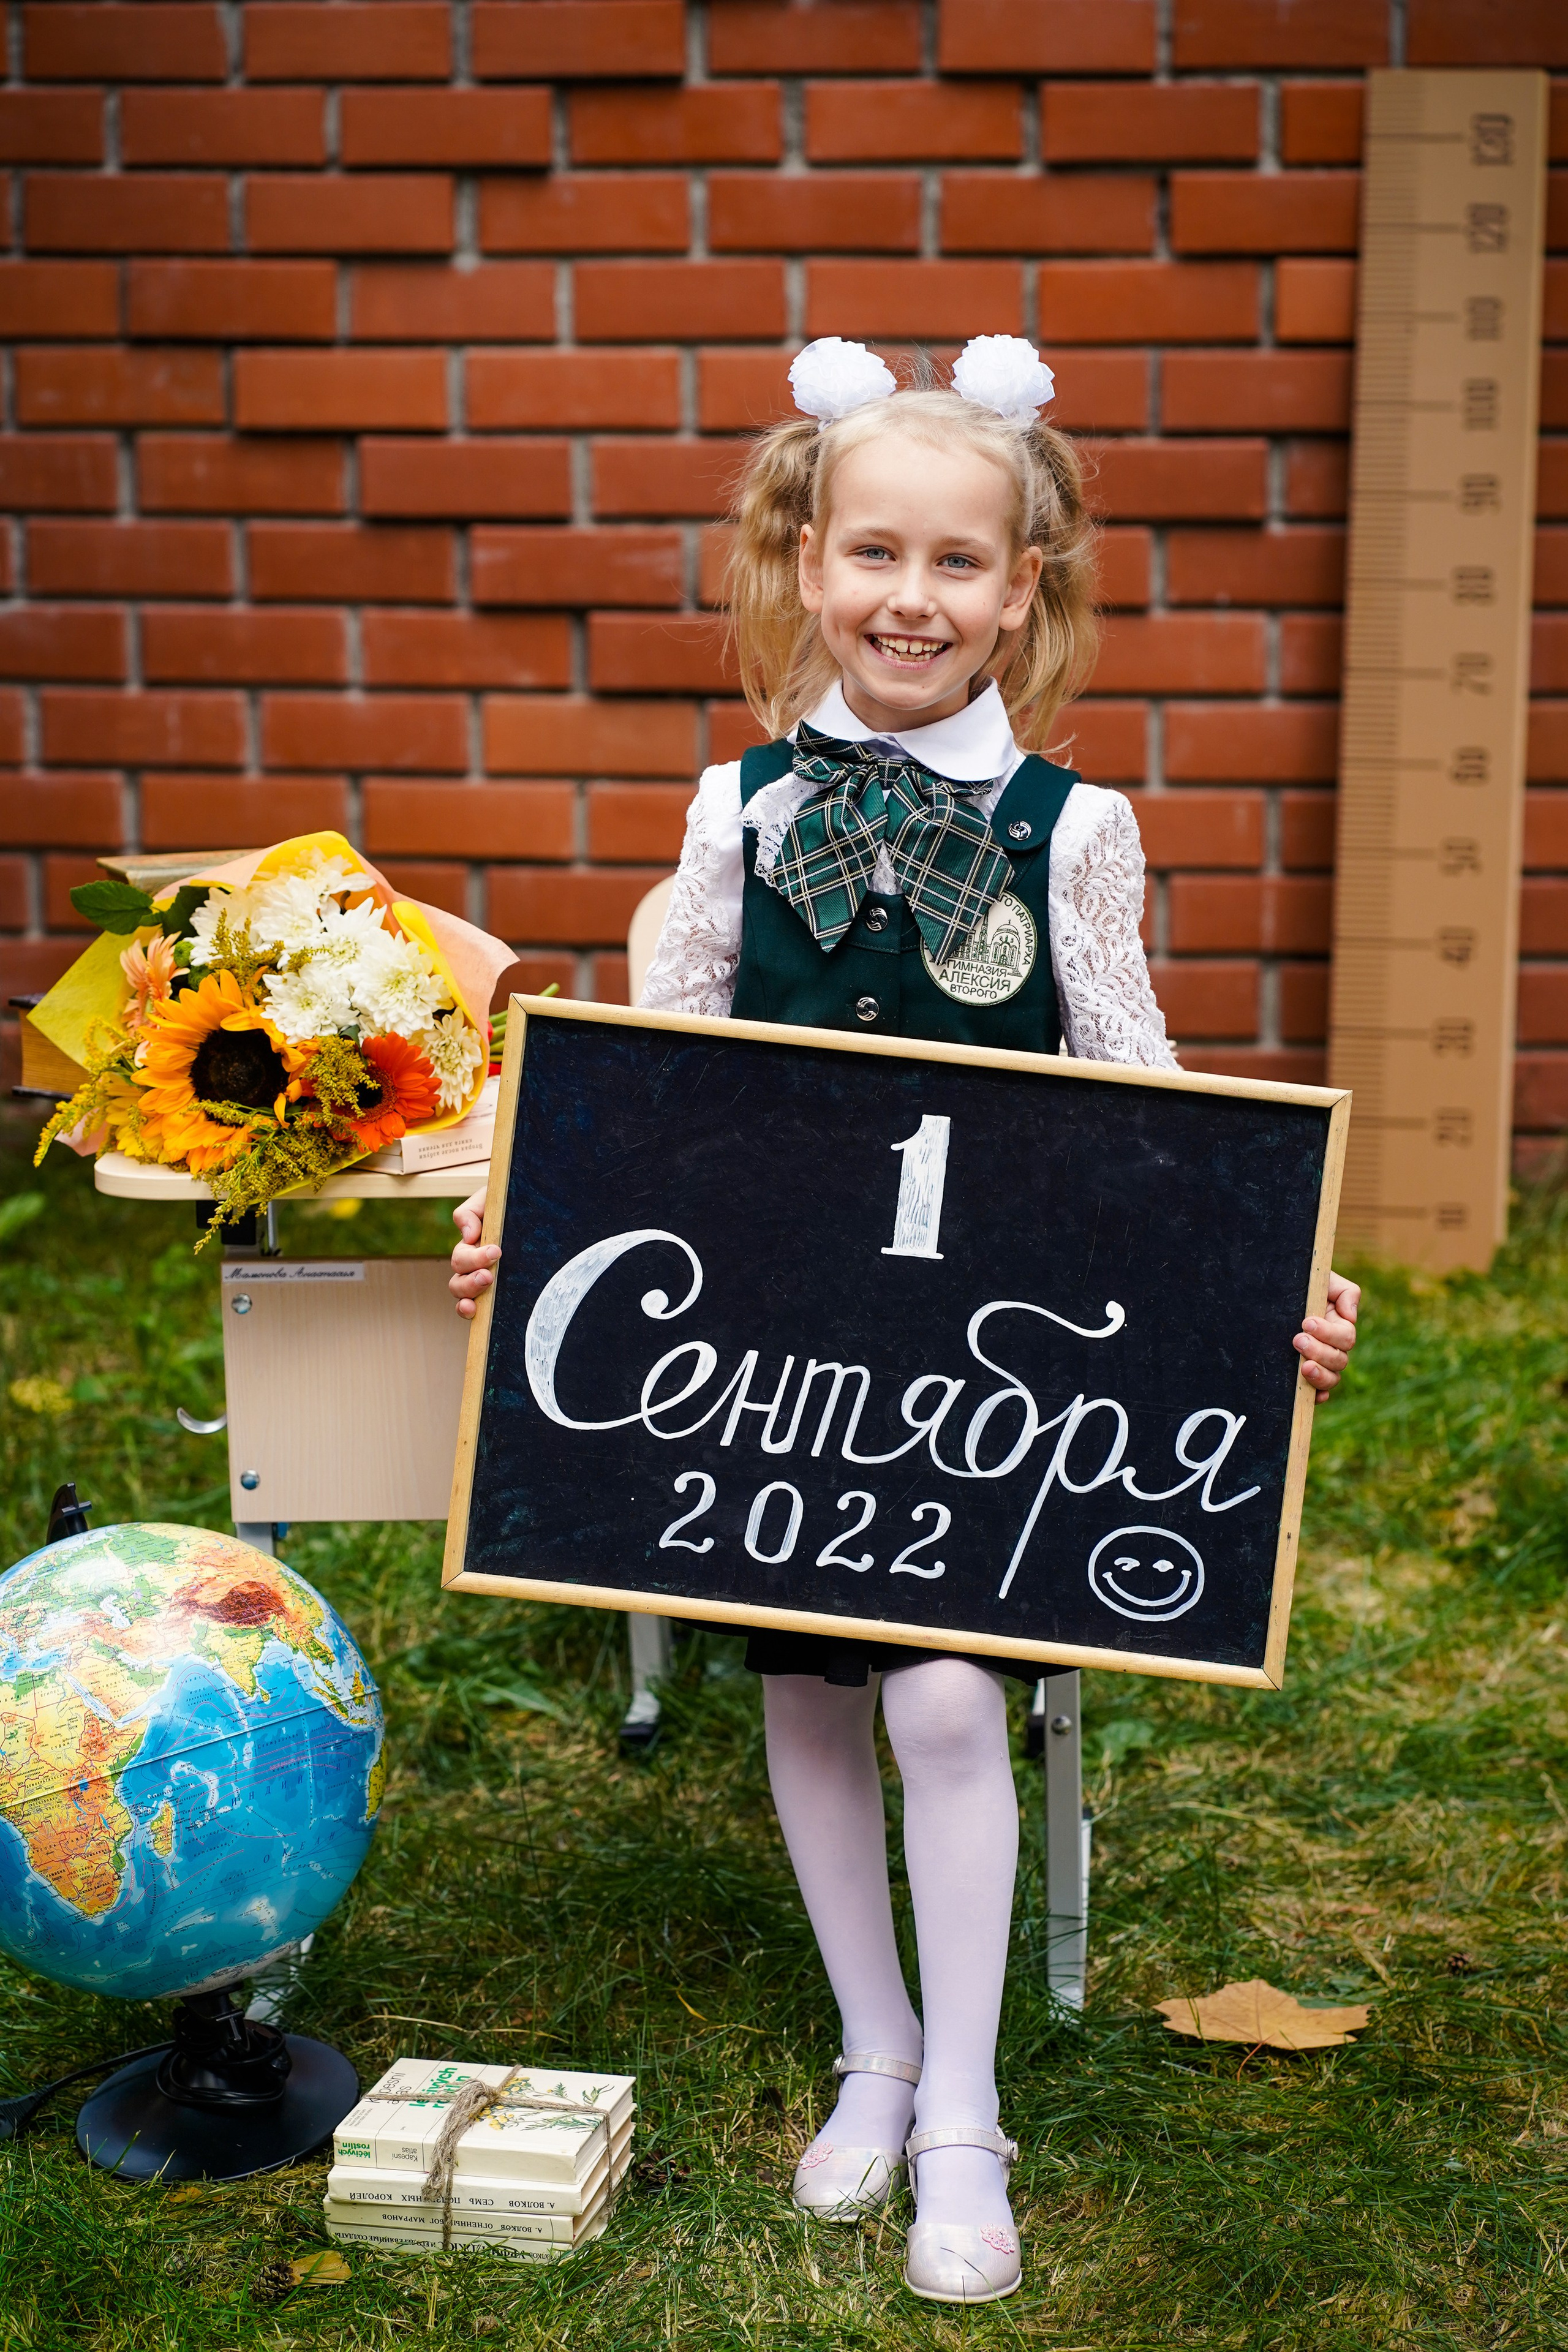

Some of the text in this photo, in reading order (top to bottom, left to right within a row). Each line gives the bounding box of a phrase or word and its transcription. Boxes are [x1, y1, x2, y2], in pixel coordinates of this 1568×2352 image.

[1012, 905, 1034, 966] ПАТРИАРХА
[947, 959, 1008, 978] ГИМНАЗИЯ
[938, 969, 1011, 992] АЛЕКСИЯ
[950, 984, 998, 1000] ВТОРОГО
[881, 1115, 950, 1259] 1
[524, 1229, 1261, 1599] Сентября
[658, 1472, 952, 1579] 2022
[365, 2071, 406, 2103] Kpesní
[409, 2067, 458, 2107] léivých
[387, 2086, 412, 2105] aas
[338, 2148, 371, 2158] léčivých
[392, 2152, 418, 2162] Kapesní
[350, 2192, 393, 2201] КОРОЛЕЙ
[402, 2195, 461, 2204] ПОДЗНЫХ
[469, 2198, 494, 2206] СЕМЬ
[509, 2200, 545, 2209] ВОЛКОВ
[382, 2213, 425, 2223] МАРРАНОВ
[450, 2219, 493, 2230] ОГНЕННЫ
[500, 2224, 532, 2233] ВОЛКОВ
[334, 2231, 368, 2241] СОЛДАТЫ
[482, 2245, 526, 2260] УРФИ
[529, 2252, 552, 2260] ОЛКОВ
